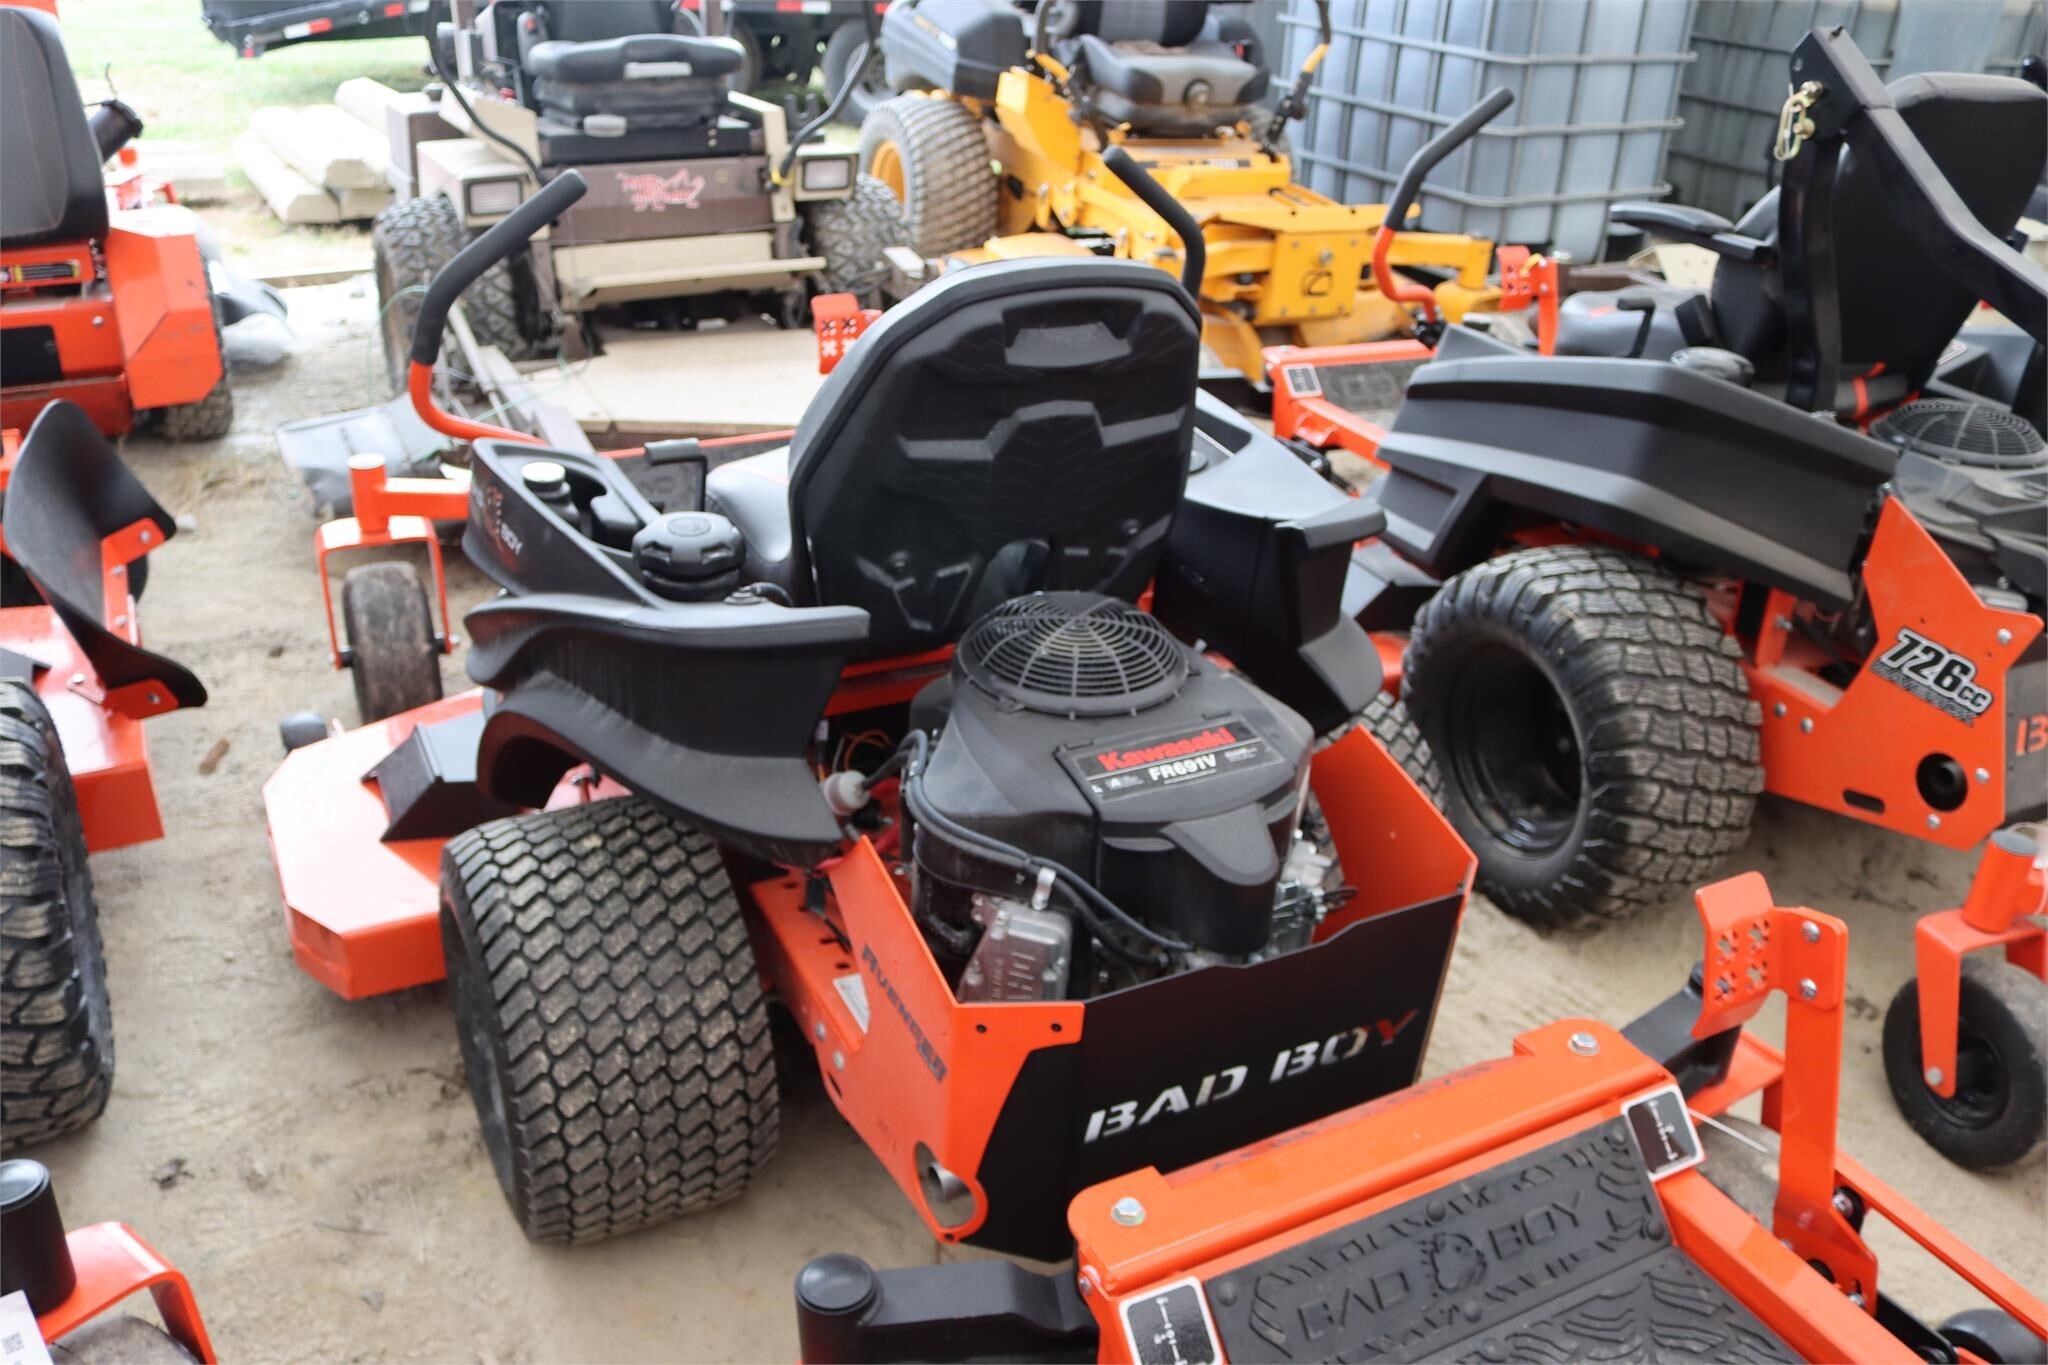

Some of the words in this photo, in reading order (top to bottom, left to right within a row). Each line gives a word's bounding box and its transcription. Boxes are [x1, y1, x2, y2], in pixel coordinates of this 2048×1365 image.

[1884, 630, 1990, 710] 726cc
[1097, 726, 1236, 772] Kawasaki
[1148, 753, 1217, 781] FR691V
[1083, 1065, 1249, 1144] BAD
[1269, 1008, 1420, 1084] BOY
[1297, 1270, 1411, 1341] BAD
[1486, 1190, 1582, 1261] BOY
